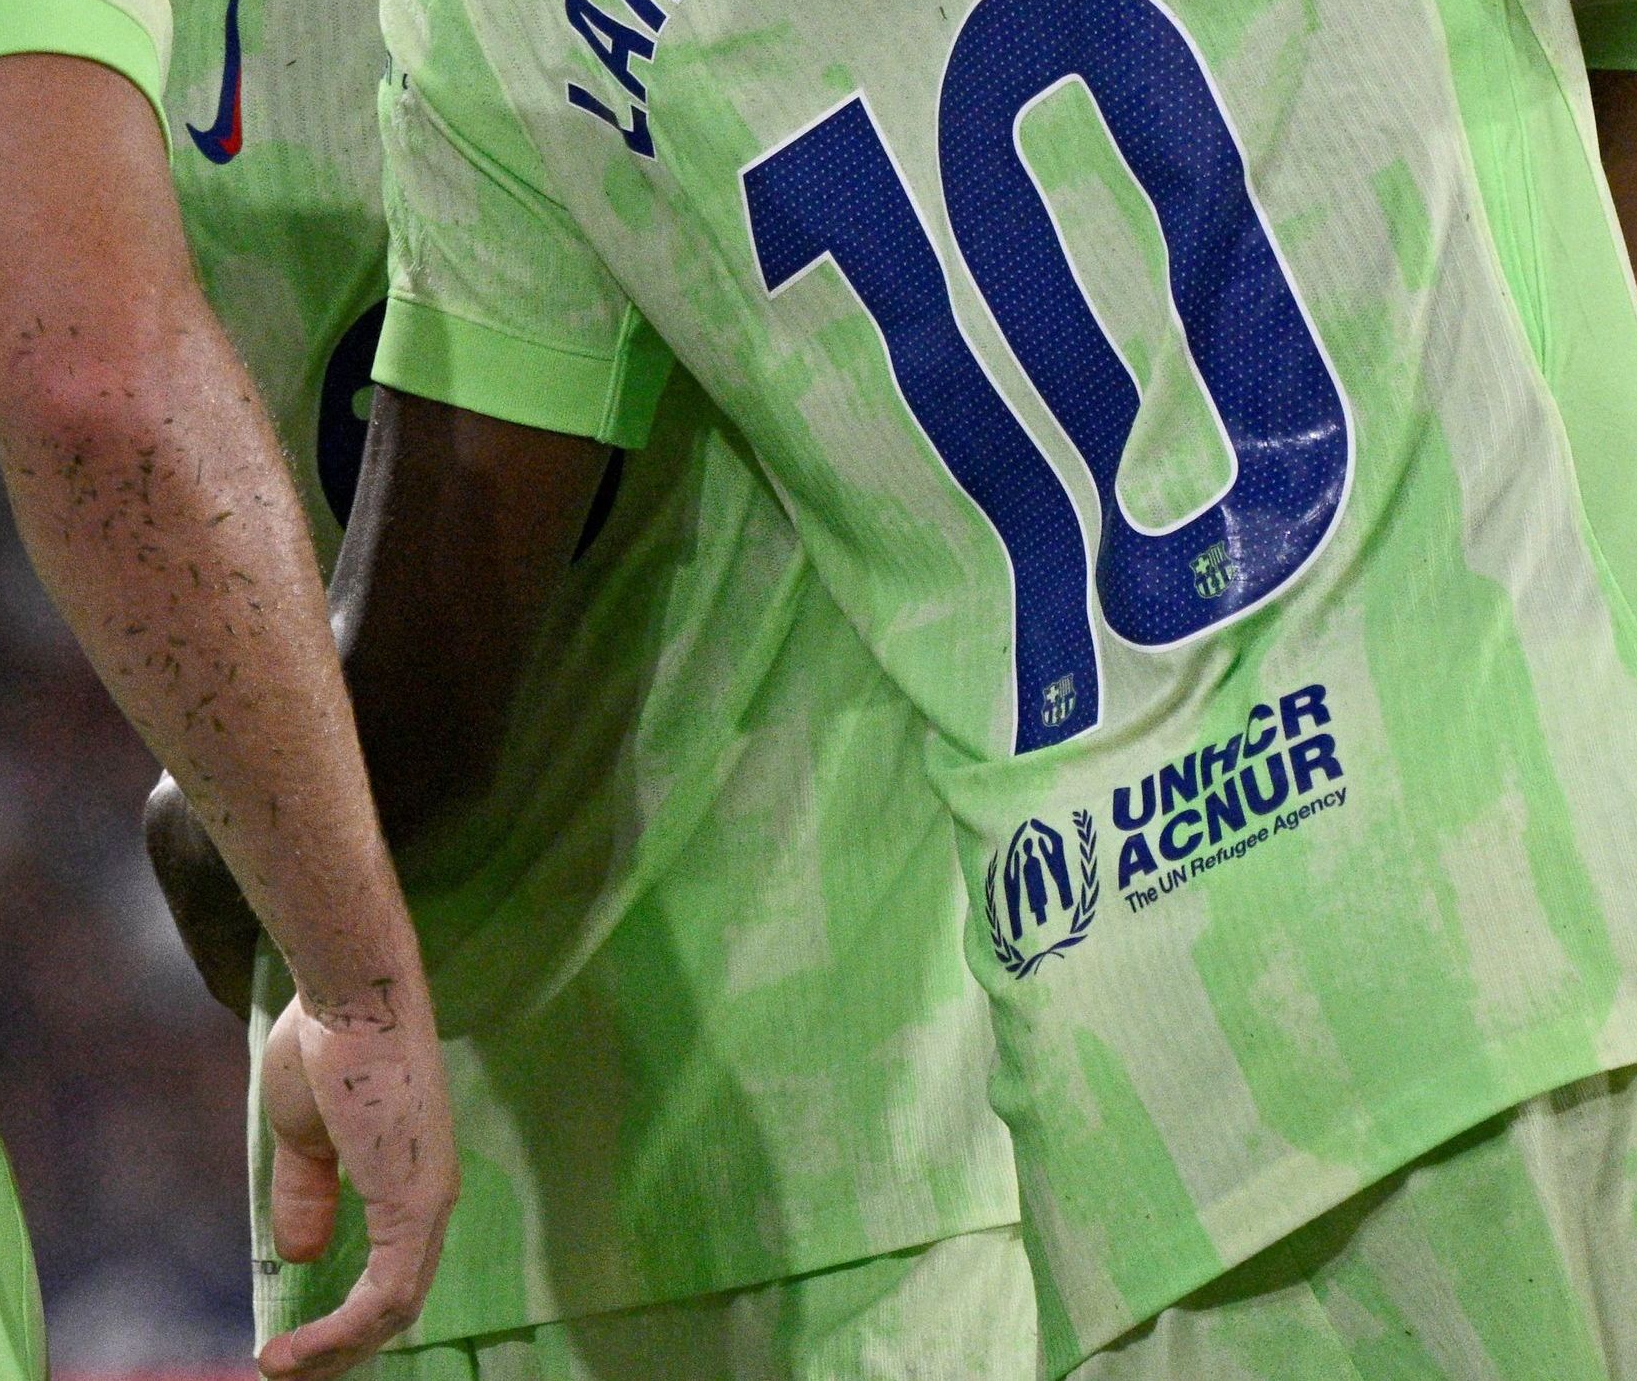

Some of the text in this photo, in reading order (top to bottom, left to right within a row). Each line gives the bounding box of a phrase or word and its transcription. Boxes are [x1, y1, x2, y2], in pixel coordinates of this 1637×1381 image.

[1112, 684, 1332, 831] UNHCR
[1118, 733, 1344, 891] ACNUR
[1124, 785, 1348, 914] The UN Refugee Agency
